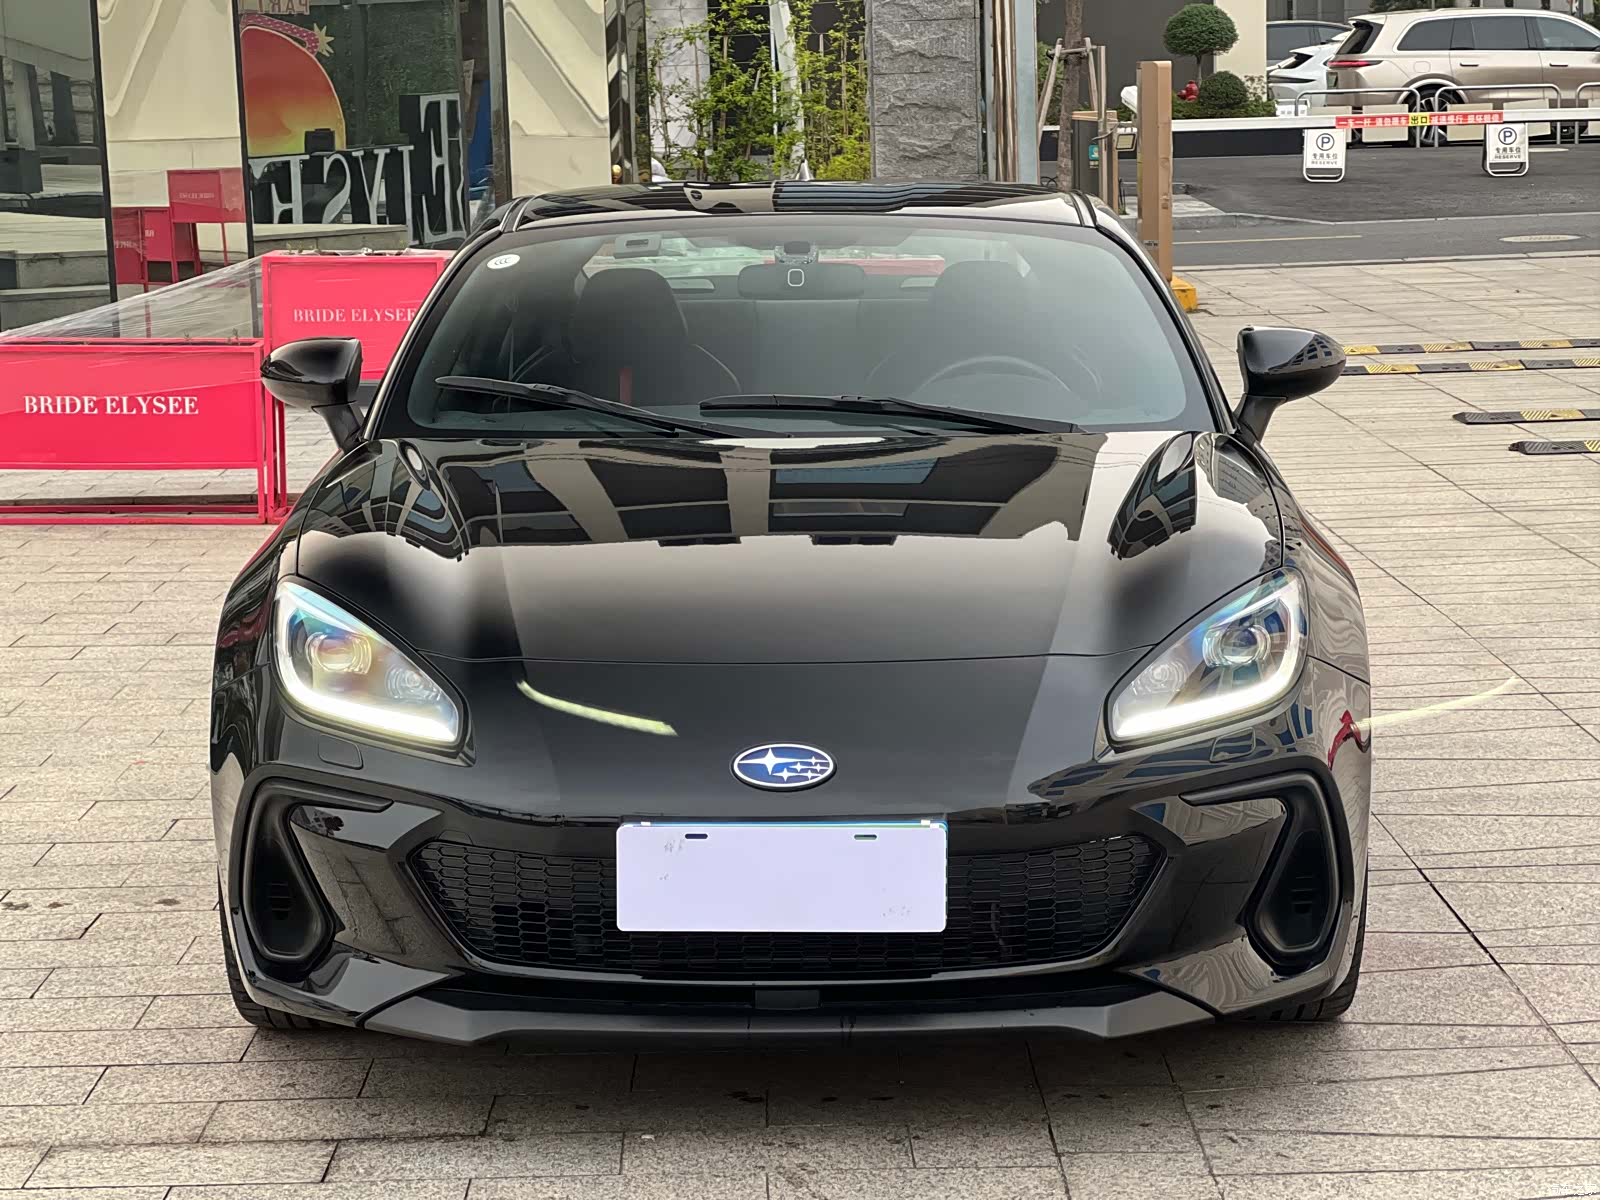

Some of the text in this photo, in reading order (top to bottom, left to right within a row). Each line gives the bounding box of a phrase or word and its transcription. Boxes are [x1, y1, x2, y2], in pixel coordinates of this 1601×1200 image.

[1410, 115, 1428, 124] 出口
[293, 308, 417, 322] BRIDE ELYSEE
[24, 395, 199, 415] BRIDE ELYSEE
